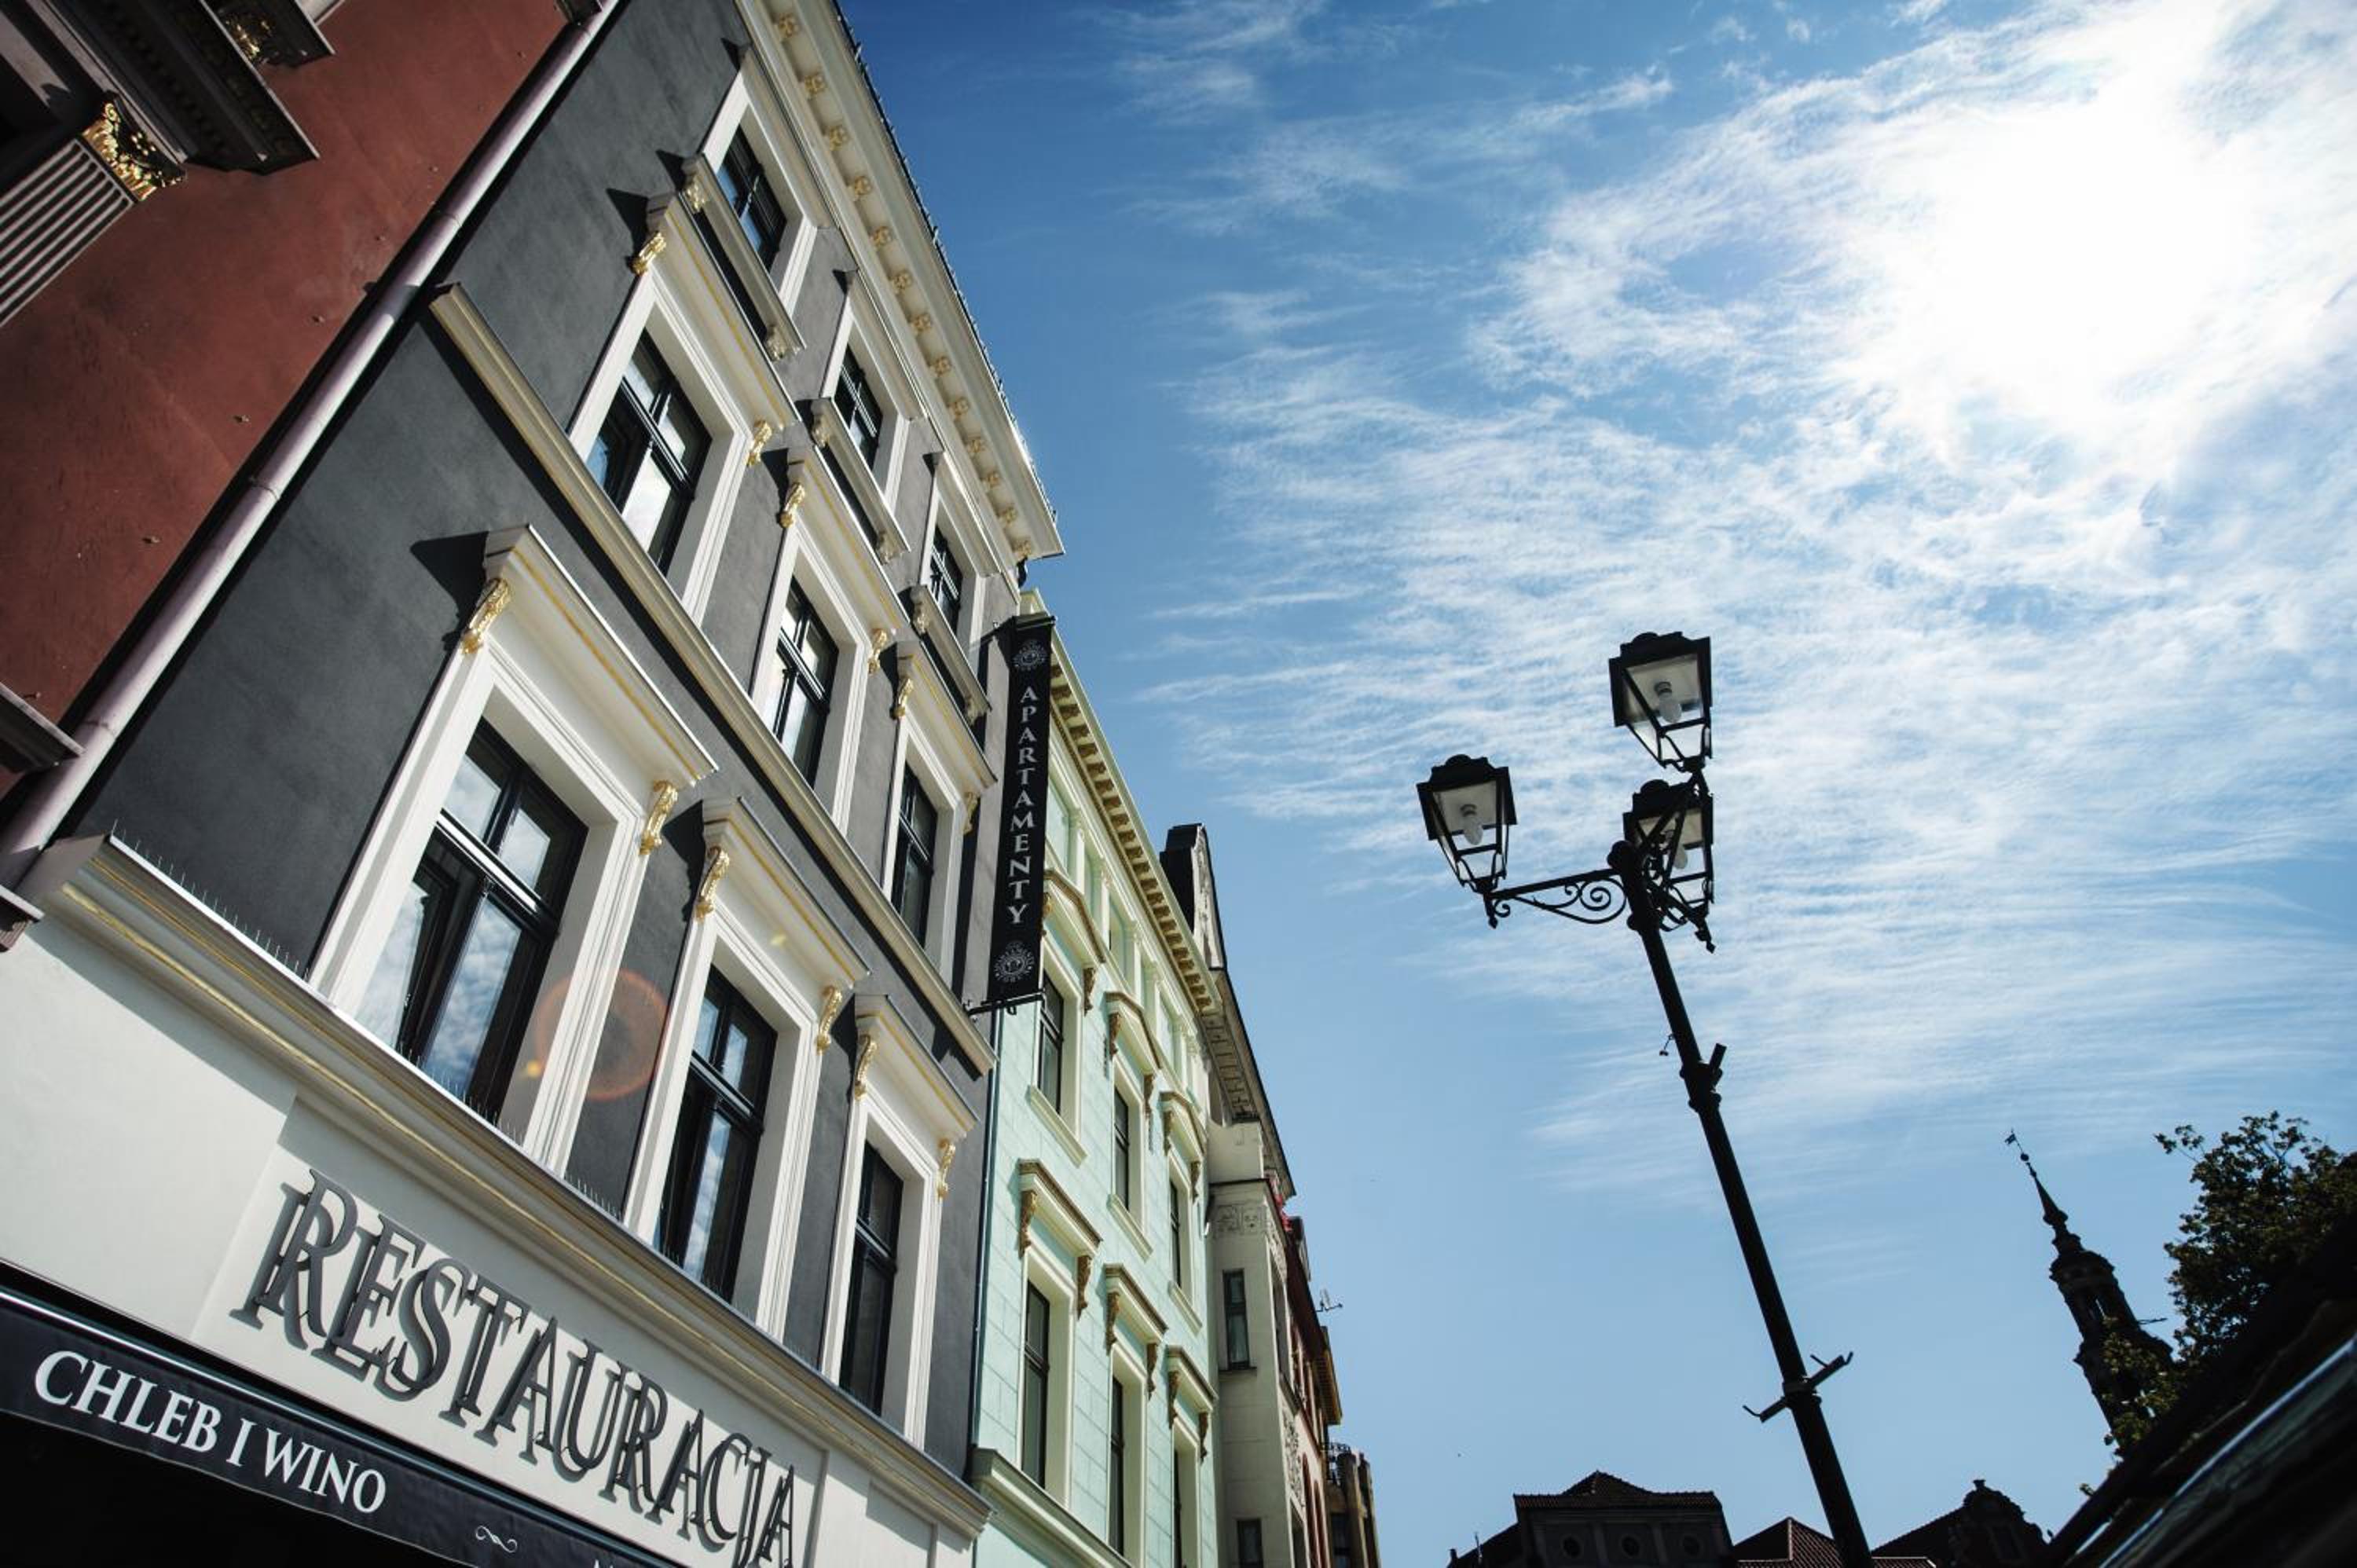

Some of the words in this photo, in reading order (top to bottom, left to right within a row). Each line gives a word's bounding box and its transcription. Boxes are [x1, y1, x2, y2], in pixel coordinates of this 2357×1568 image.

[1009, 684, 1039, 925] APARTAMENTY
[34, 1350, 222, 1453] CHLEB
[225, 1417, 258, 1467] I
[264, 1427, 387, 1514] WINO
[254, 1167, 794, 1568] RESTAURACJA
